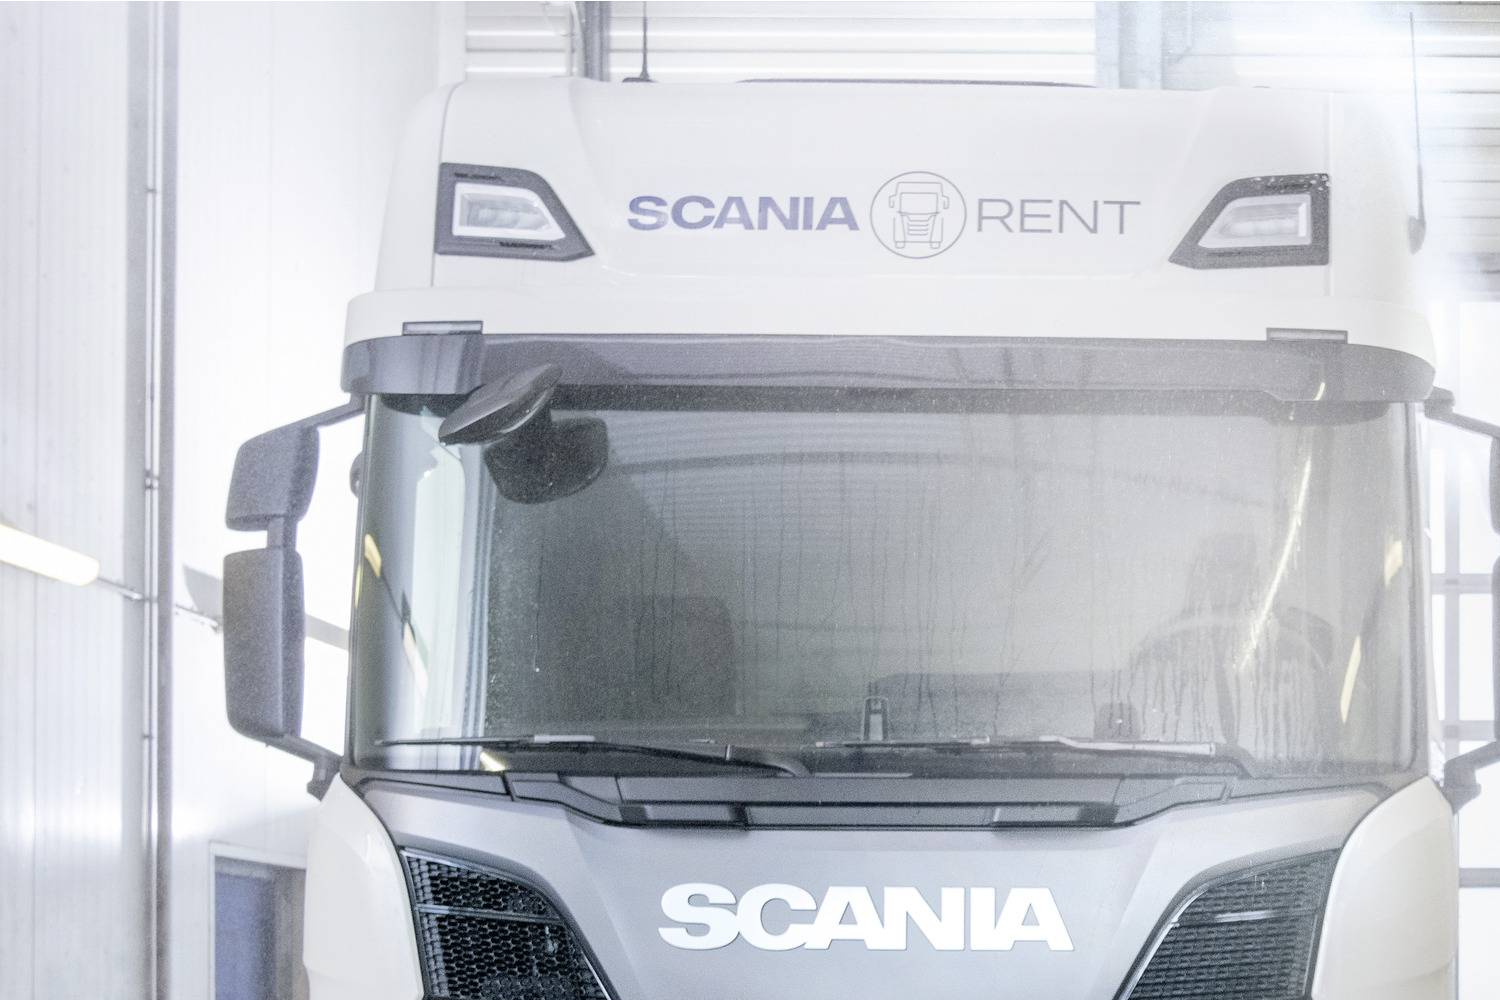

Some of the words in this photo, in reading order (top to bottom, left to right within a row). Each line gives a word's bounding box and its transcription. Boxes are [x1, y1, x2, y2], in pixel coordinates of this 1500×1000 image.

[627, 195, 861, 232] SCANIA
[976, 198, 1142, 234] RENT
[657, 882, 1076, 952] SCANIA
